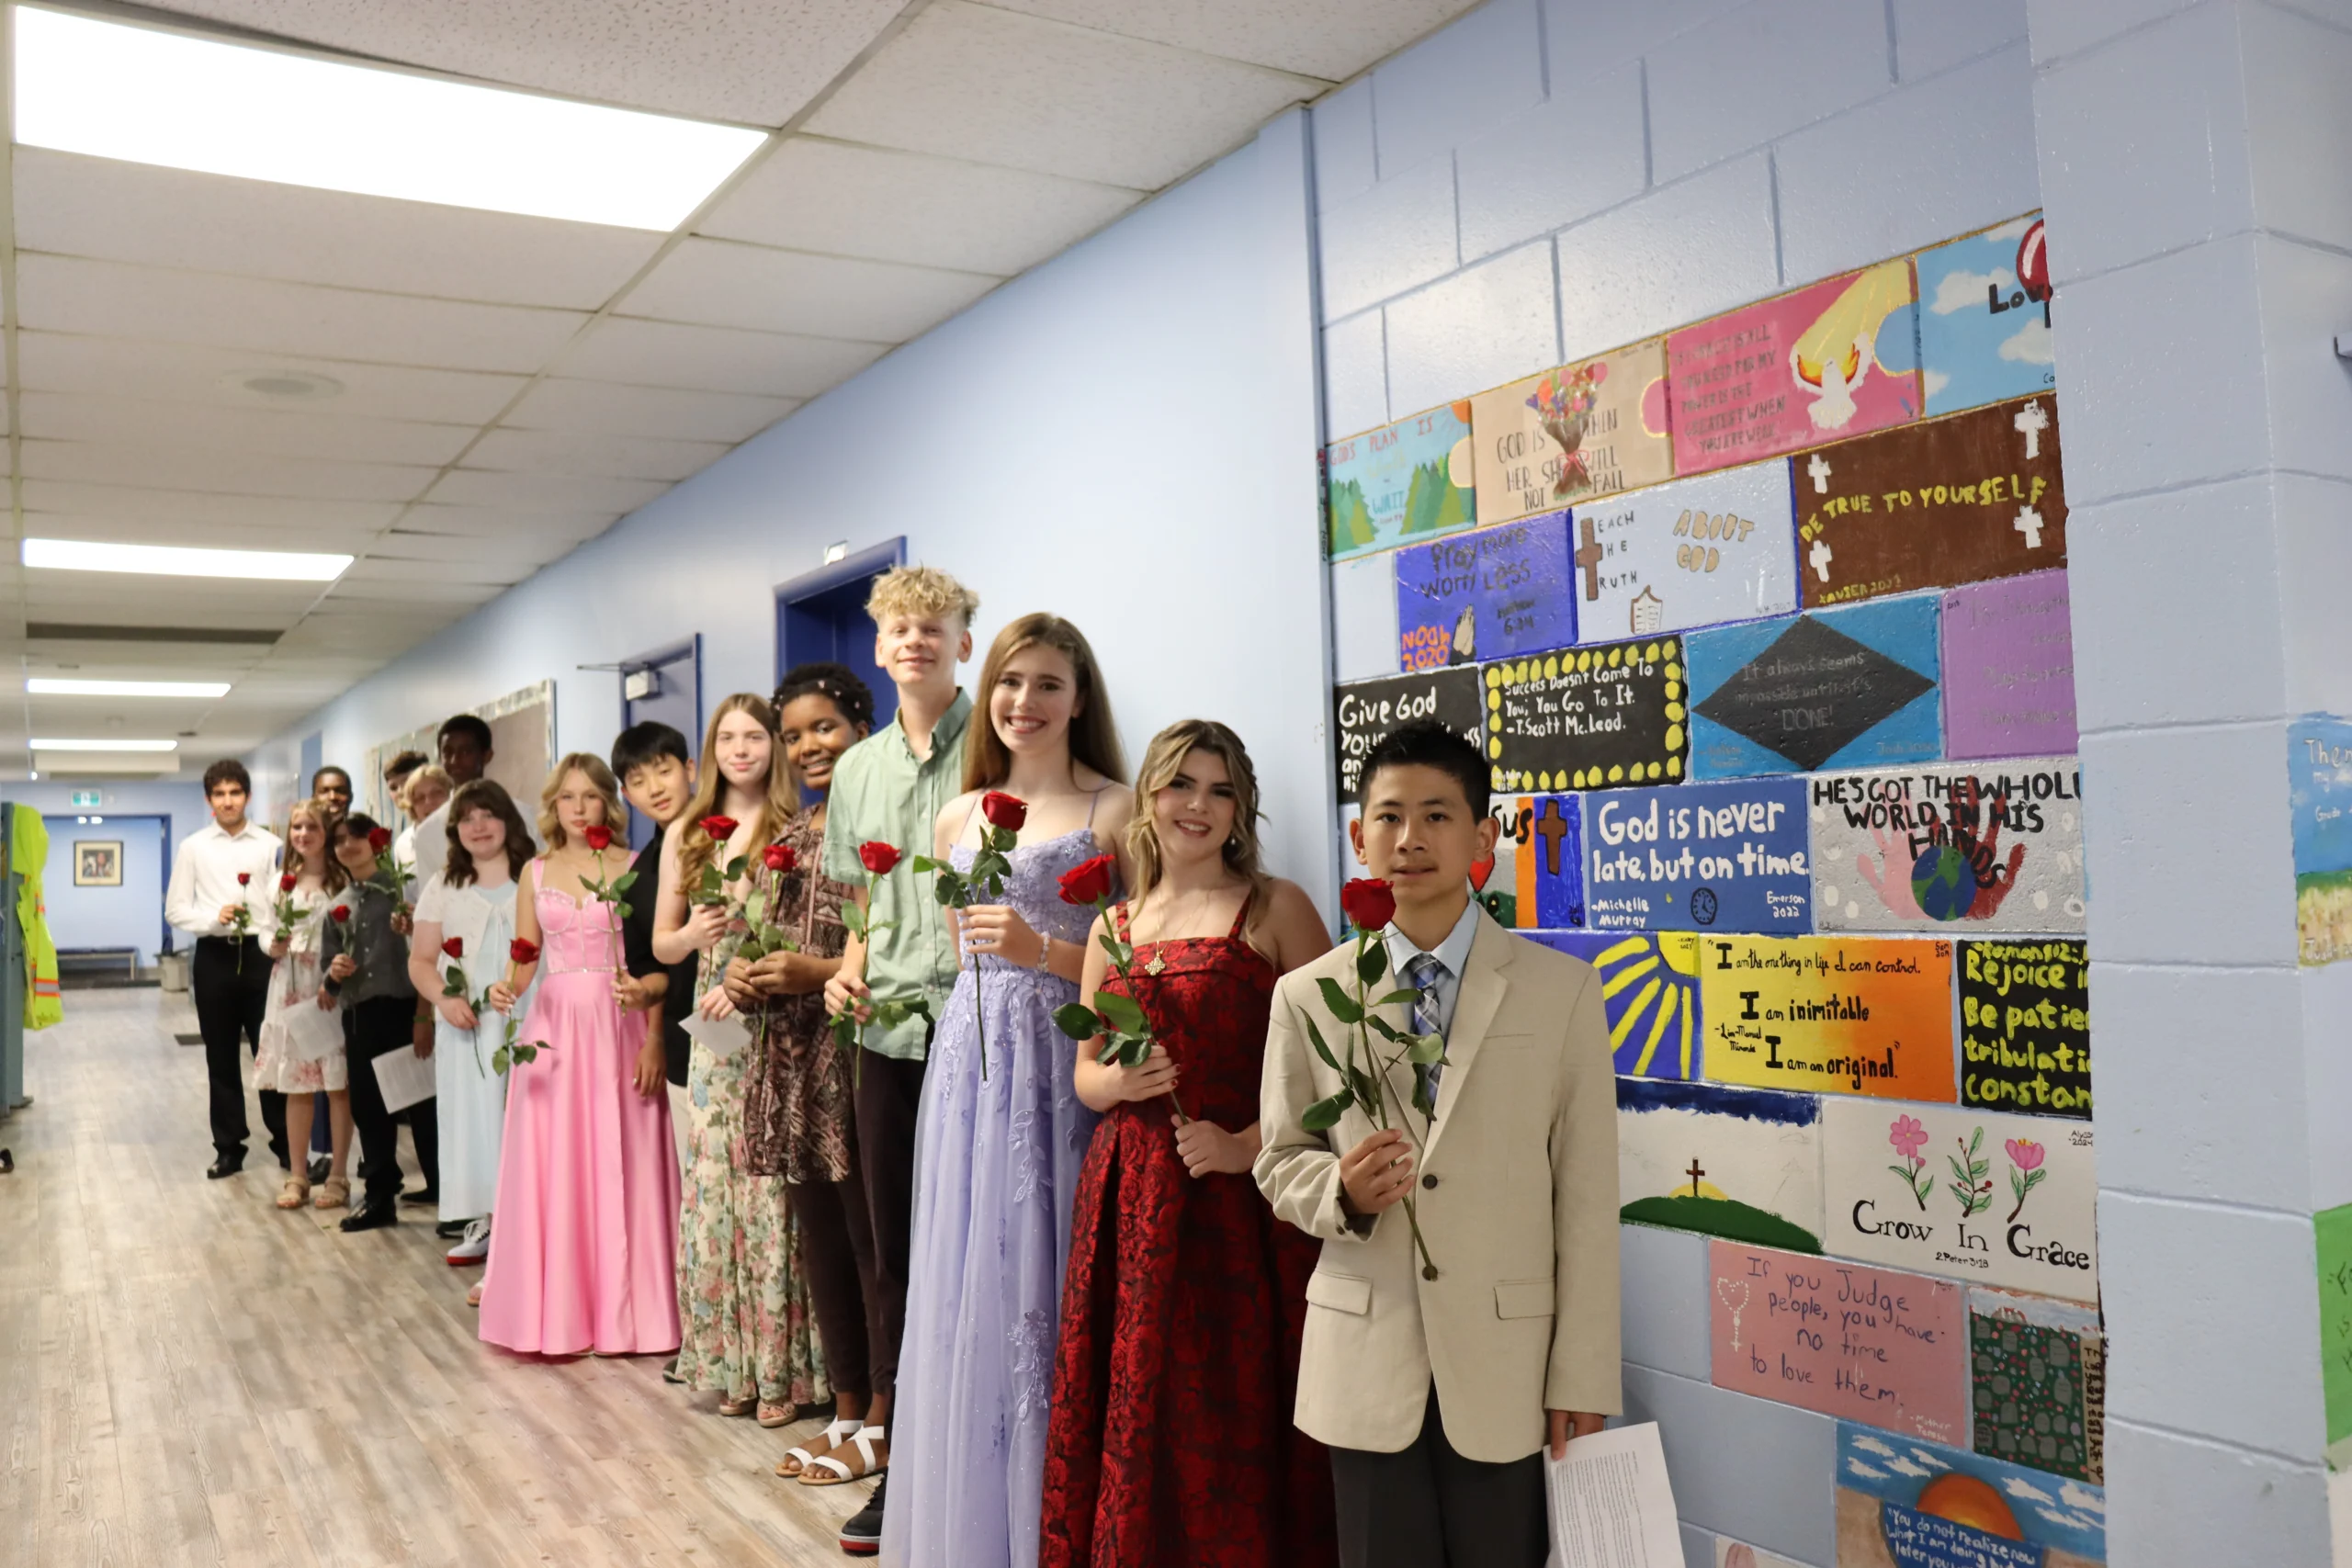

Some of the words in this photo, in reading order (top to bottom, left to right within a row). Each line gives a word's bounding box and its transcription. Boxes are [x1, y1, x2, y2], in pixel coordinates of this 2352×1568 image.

[1747, 396, 1786, 421] WHEN
[1369, 429, 1398, 453] PLAN
[1417, 416, 1433, 436] IS
[1497, 432, 1526, 465] GOD
[1532, 430, 1545, 453] IS
[1507, 466, 1532, 492] HER
[1823, 494, 1872, 519] TRUE
[1883, 490, 1913, 513] TO
[1920, 474, 2047, 508] YOURSELF
[1673, 509, 1755, 542] ABOUT
[1677, 544, 1720, 573] GOD
[1402, 644, 1450, 672] 2020
[1767, 654, 1815, 676] always
[1504, 679, 1545, 696] Success
[1593, 666, 1630, 684] Come
[1637, 657, 1654, 677] To
[1339, 694, 1391, 728] Give
[1396, 686, 1436, 720] God
[1536, 695, 1558, 715] You
[1562, 690, 1585, 712] Go
[1593, 689, 1608, 706] To
[1781, 704, 1834, 731] DONE!
[1341, 753, 1366, 773] an
[1868, 776, 1914, 804] GOT
[1922, 775, 1969, 799] THE
[1599, 797, 1658, 846] God
[1668, 807, 1690, 840] is
[1698, 800, 1785, 840] never
[1844, 801, 1939, 829] WORLD
[1946, 801, 1980, 828] IN
[1989, 800, 2044, 833] HIS
[1649, 846, 1694, 882] but
[1699, 856, 1733, 880] on
[1736, 841, 1810, 878] time.
[1766, 890, 1805, 905] Emerson
[1772, 906, 1801, 919] 2022
[1736, 958, 1749, 968] am
[1747, 948, 1762, 969] the
[1765, 959, 1780, 969] one
[1780, 950, 1802, 976] thing
[1804, 956, 1813, 969] in
[1815, 951, 1829, 977] life
[1849, 961, 1871, 973] can
[1875, 957, 1921, 975] control.
[1966, 949, 2067, 997] Rejoice
[1739, 991, 1759, 1020] I
[1765, 1009, 1784, 1021] am
[1790, 993, 1870, 1022] inimitable
[1964, 997, 1998, 1029] Be
[1765, 1035, 1783, 1069] I
[1787, 1058, 1807, 1070] am
[1810, 1062, 1825, 1073] an
[1852, 1199, 1933, 1242] Grow
[1958, 1223, 1989, 1252] In
[2007, 1224, 2090, 1270] Grace
[1747, 1257, 1771, 1278] If
[1786, 1272, 1820, 1299] you
[1837, 1269, 1910, 1324] Judge
[1840, 1309, 1877, 1332] you
[1797, 1329, 1823, 1351] no
[1841, 1333, 1888, 1362] time
[1750, 1343, 1767, 1374] to
[1781, 1353, 1814, 1383] love
[1835, 1367, 1905, 1407] them.
[1894, 1540, 1928, 1563] later
[1917, 1517, 1930, 1532] do
[1933, 1524, 1956, 1539] not
[1958, 1530, 2009, 1559] realize
[2010, 1549, 2036, 1565] now
[1918, 1533, 1926, 1545] I
[1928, 1538, 1947, 1551] am
[1950, 1541, 1987, 1568] doing
